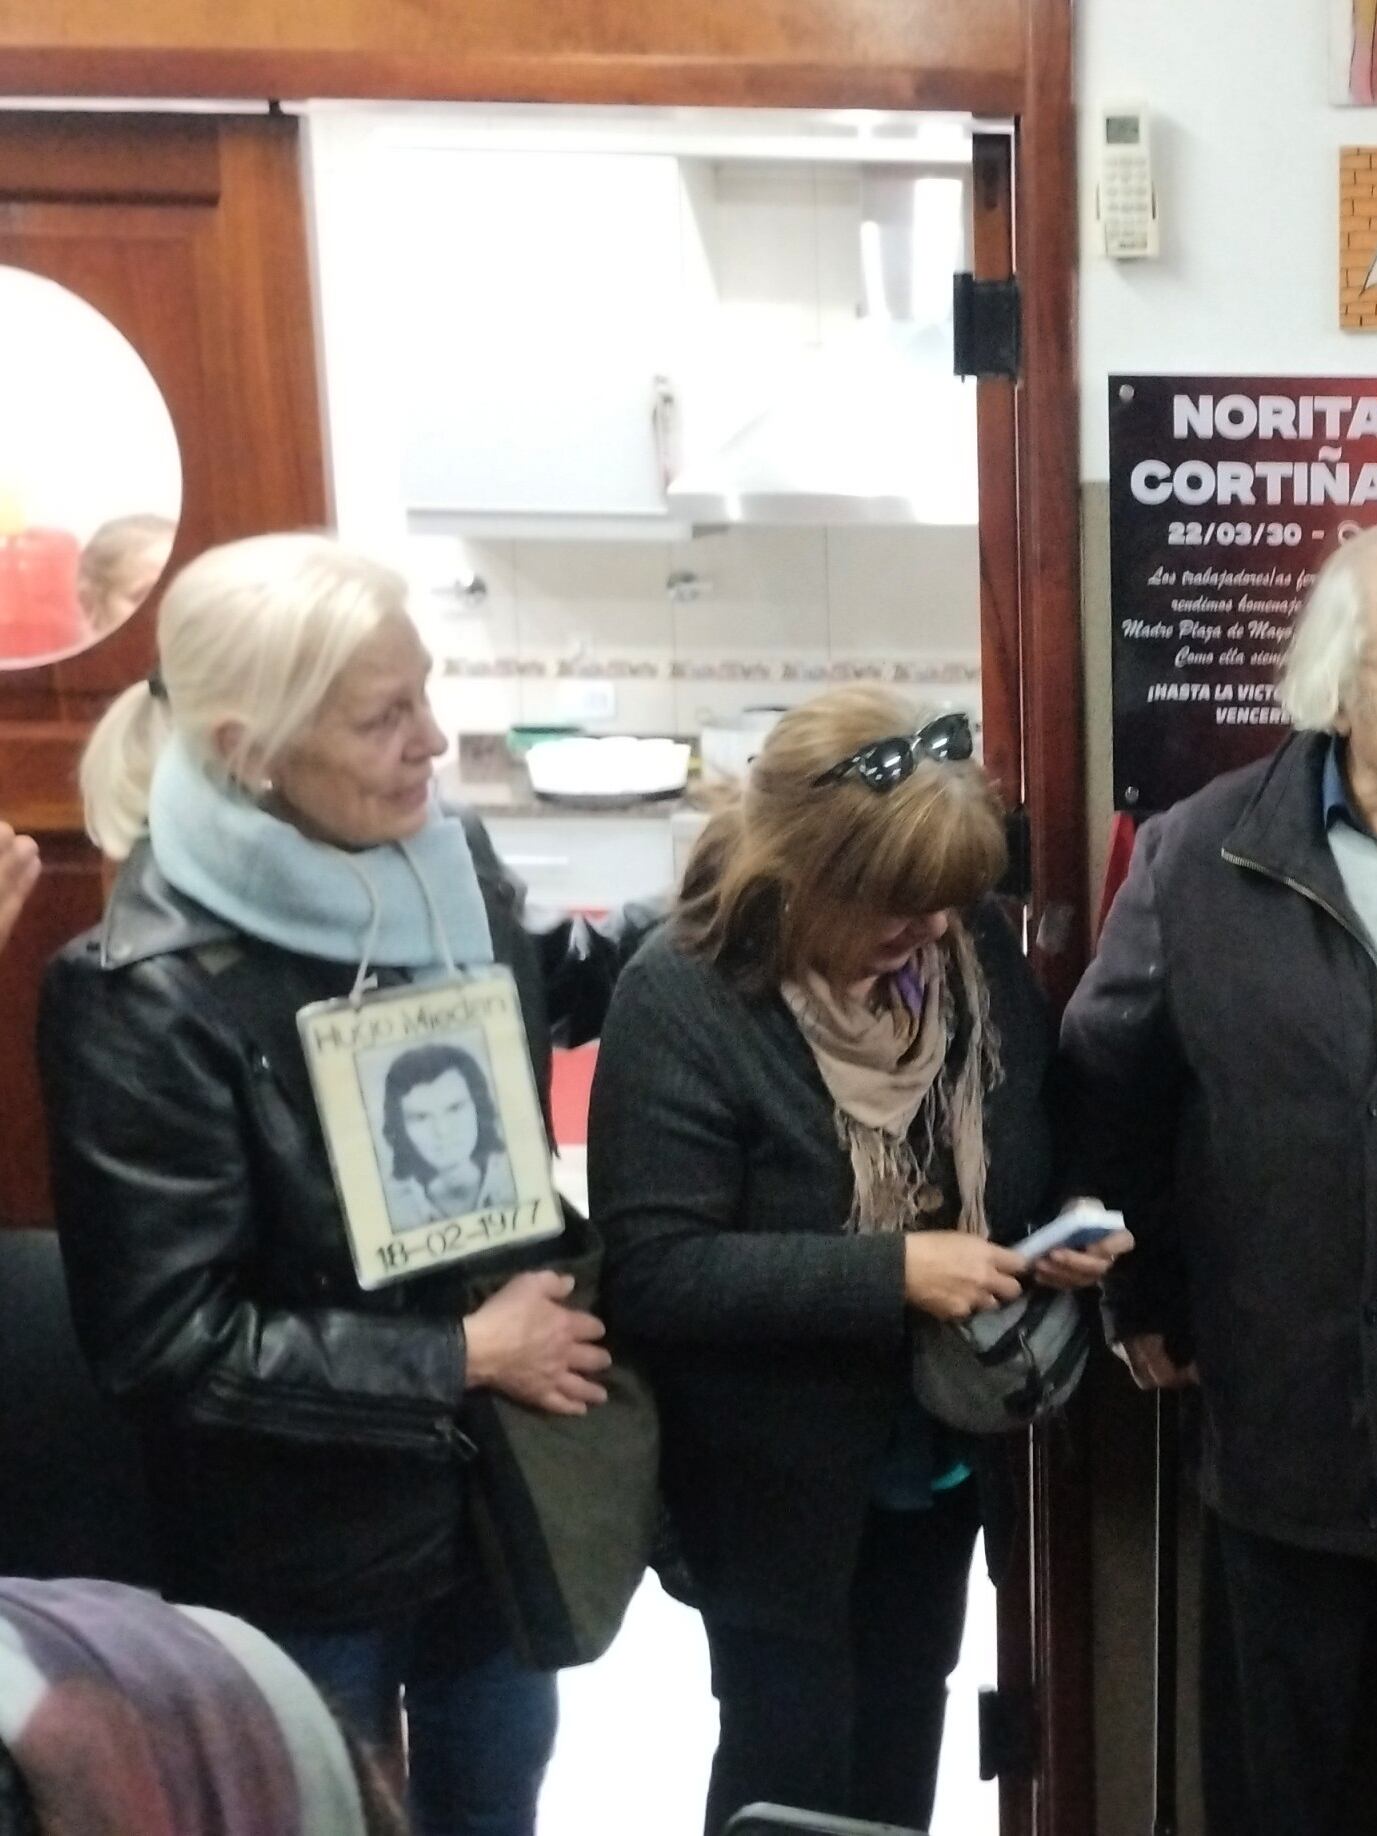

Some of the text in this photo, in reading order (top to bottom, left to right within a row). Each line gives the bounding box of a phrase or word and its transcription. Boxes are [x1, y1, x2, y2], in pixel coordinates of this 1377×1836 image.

[1167, 521, 1302, 546] 22/03/30
[1147, 565, 1177, 586] Los
[1171, 595, 1233, 613] rendimos
[1121, 619, 1174, 640] Madre
[1179, 619, 1222, 645] Plaza
[1226, 622, 1245, 640] de
[1174, 645, 1214, 668] Como
[1218, 647, 1245, 666] ella
[1214, 683, 1234, 701] LA
